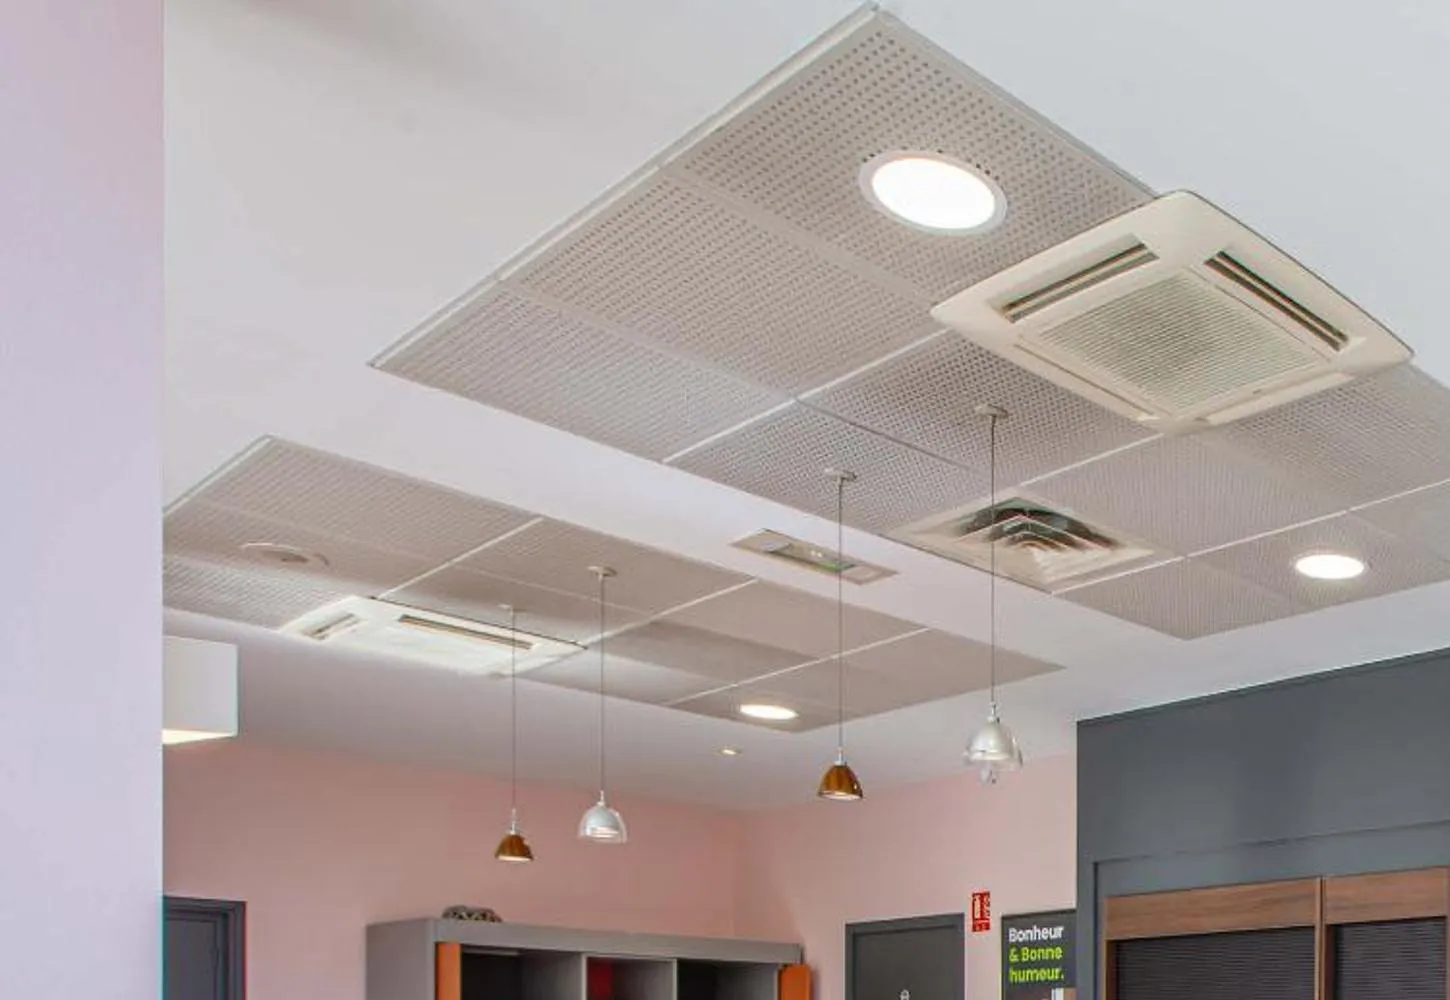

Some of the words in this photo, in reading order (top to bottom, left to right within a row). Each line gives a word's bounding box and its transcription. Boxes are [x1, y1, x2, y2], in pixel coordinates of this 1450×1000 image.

[1008, 924, 1064, 943] Bonheur
[1009, 948, 1019, 962] &
[1021, 946, 1063, 962] Bonne
[1009, 967, 1064, 983] humeur.
